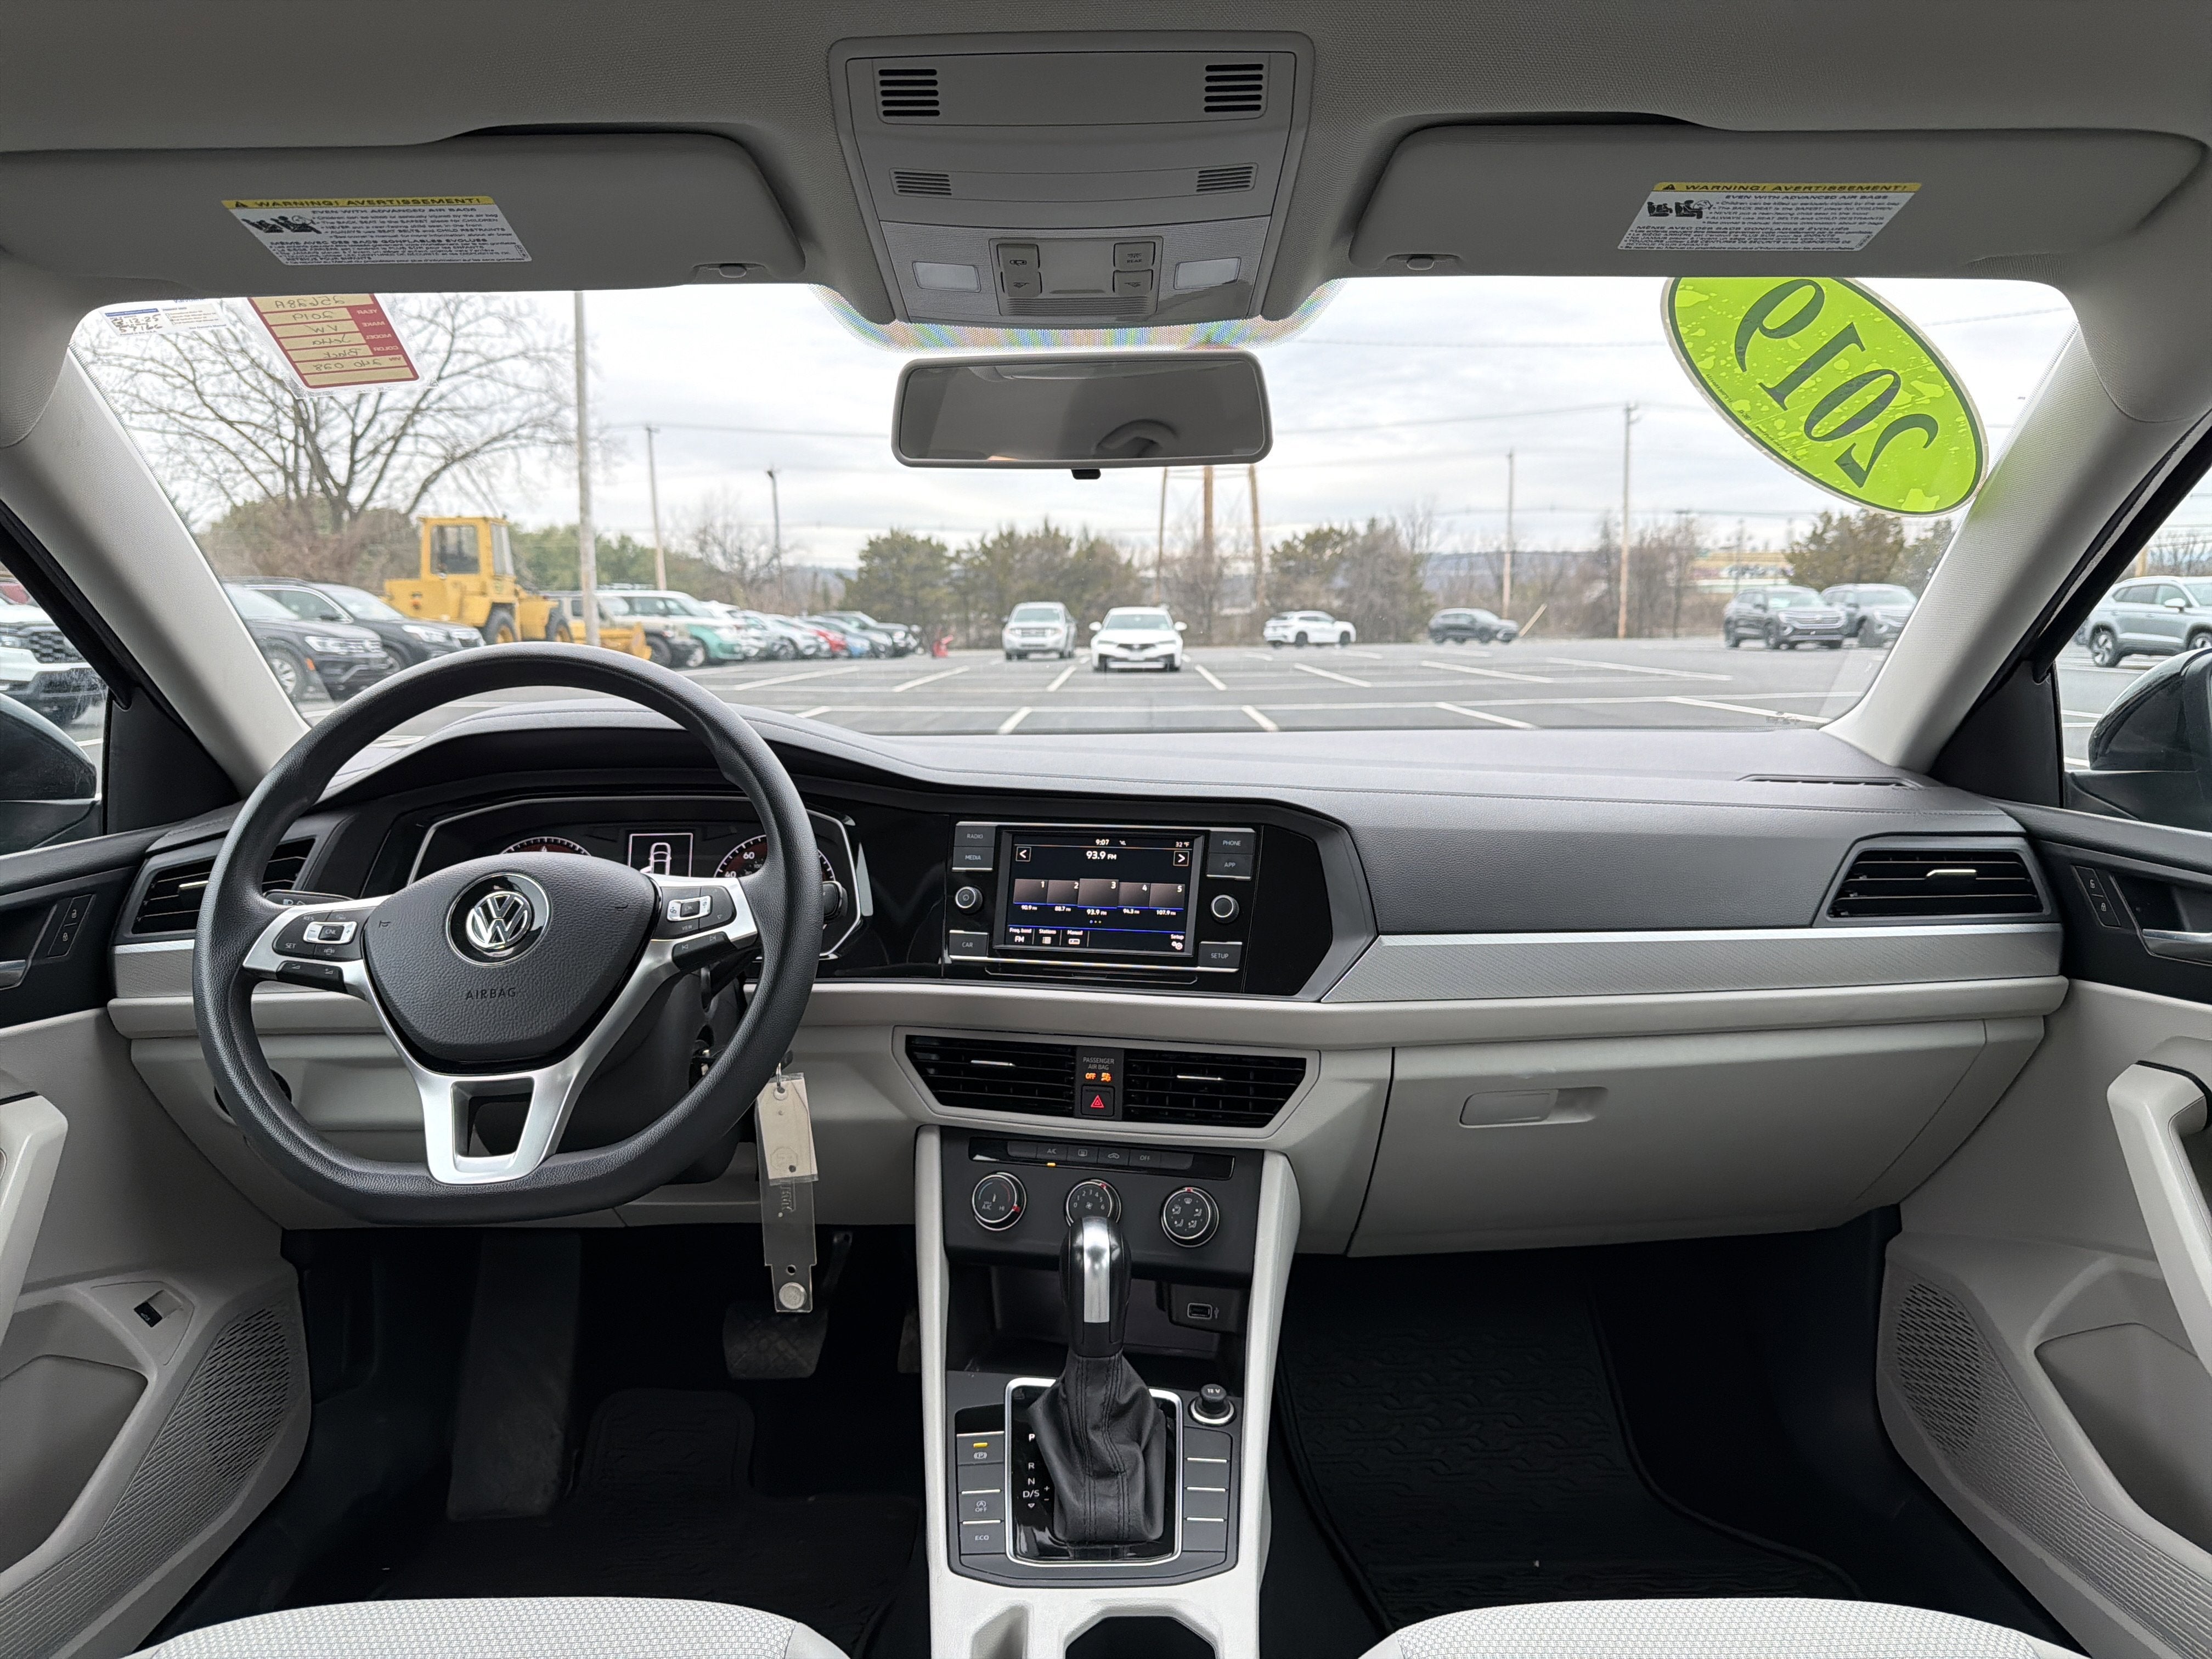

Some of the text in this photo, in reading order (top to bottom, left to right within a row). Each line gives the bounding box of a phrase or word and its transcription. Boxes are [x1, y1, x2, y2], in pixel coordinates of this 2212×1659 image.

[346, 198, 480, 206] AVERTISSEMENT!
[743, 851, 755, 860] 60
[1086, 850, 1106, 860] 93.9
[1110, 881, 1116, 889] 3
[466, 988, 516, 1000] AIRBAG
[1028, 1434, 1035, 1442] P
[1028, 1462, 1035, 1470] R
[1028, 1477, 1035, 1486] N
[1023, 1489, 1040, 1499] D/S
